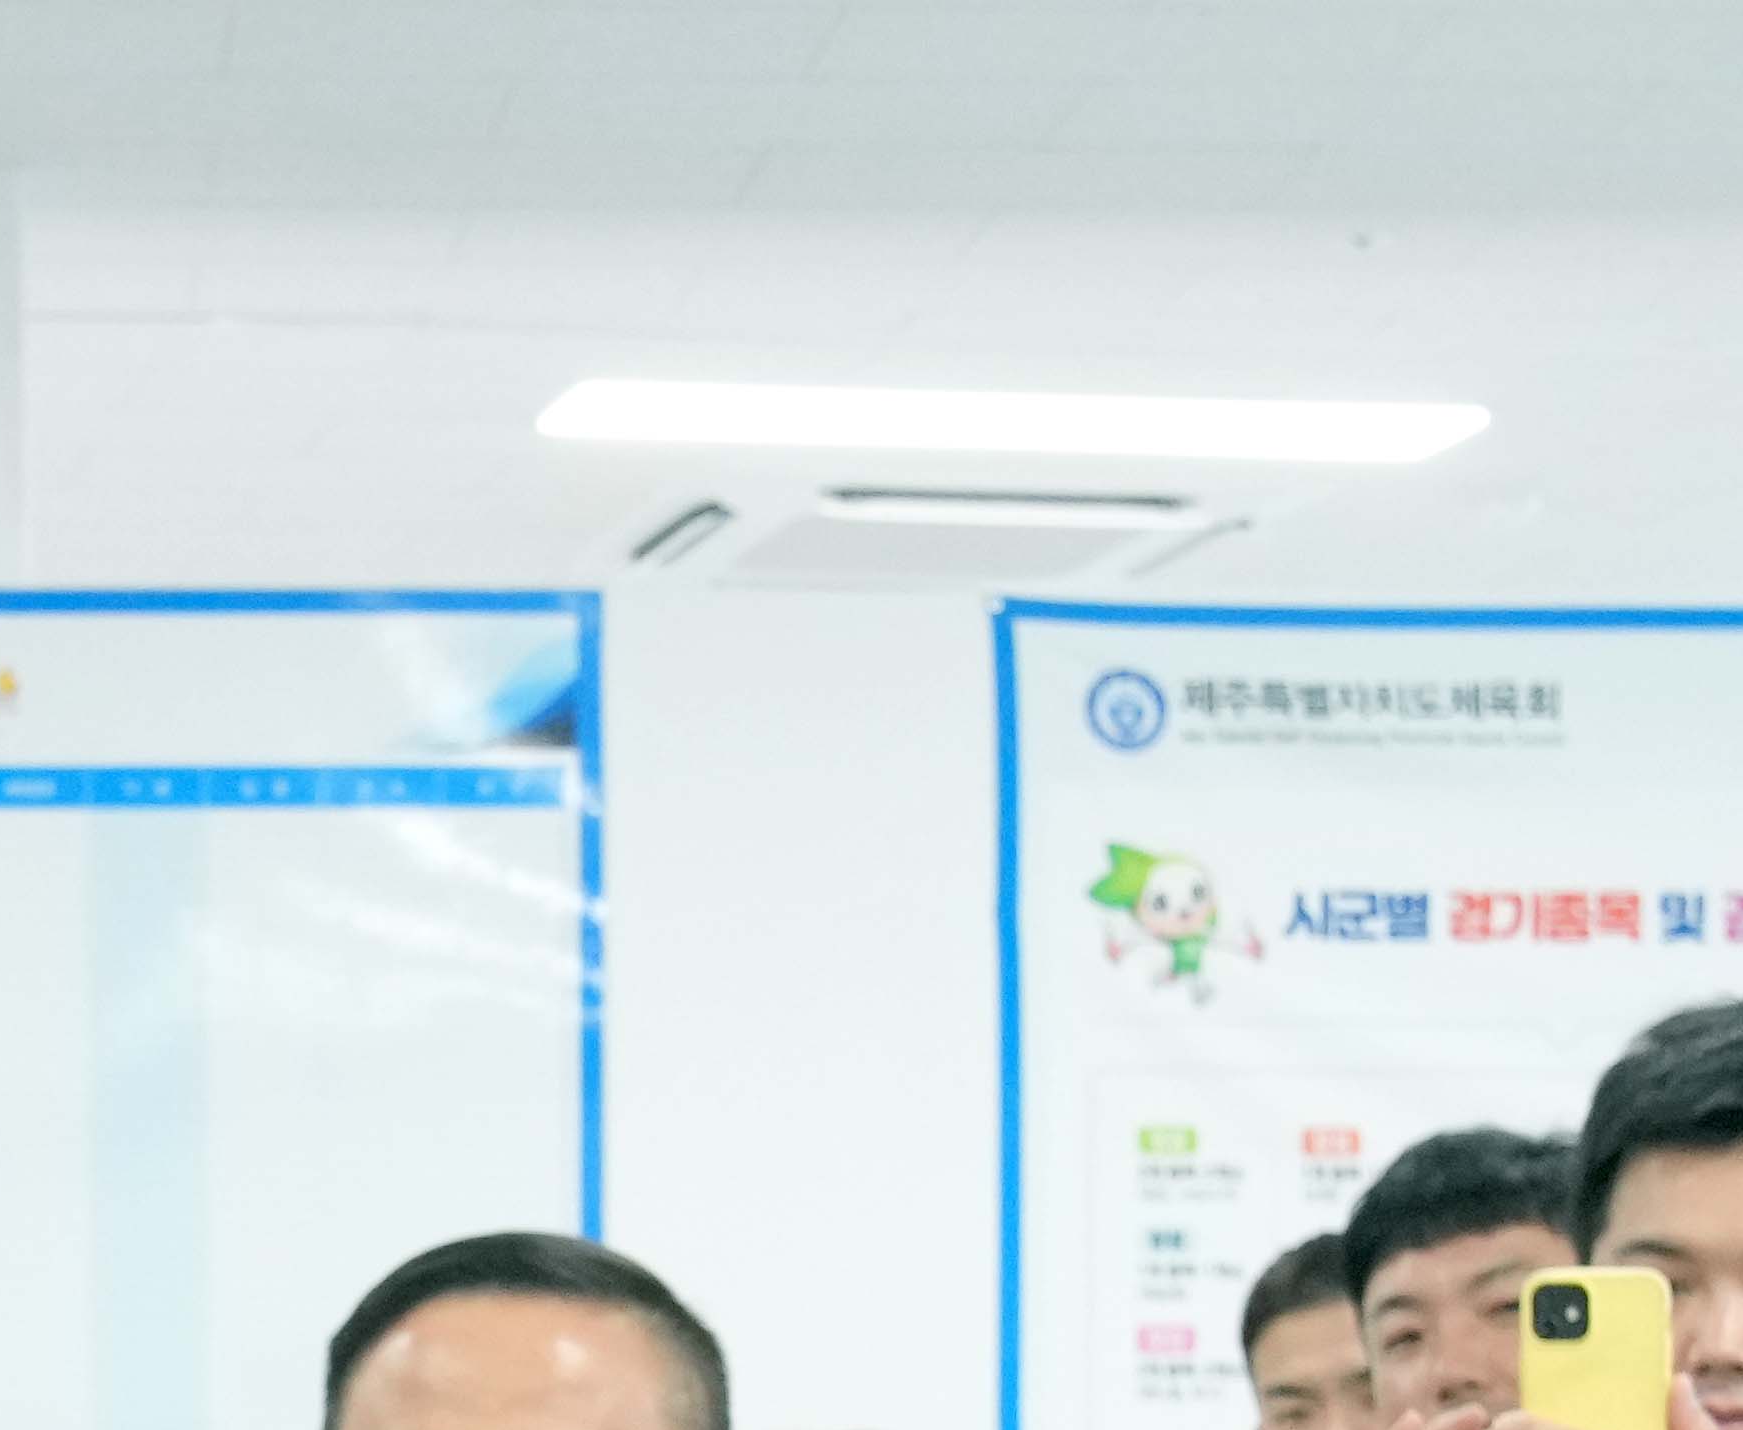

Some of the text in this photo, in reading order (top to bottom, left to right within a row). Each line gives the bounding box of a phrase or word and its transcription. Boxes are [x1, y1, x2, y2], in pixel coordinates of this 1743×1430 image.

[1286, 891, 1429, 941] 시군별
[1449, 891, 1641, 942] 경기종목
[1658, 891, 1704, 940] 및
